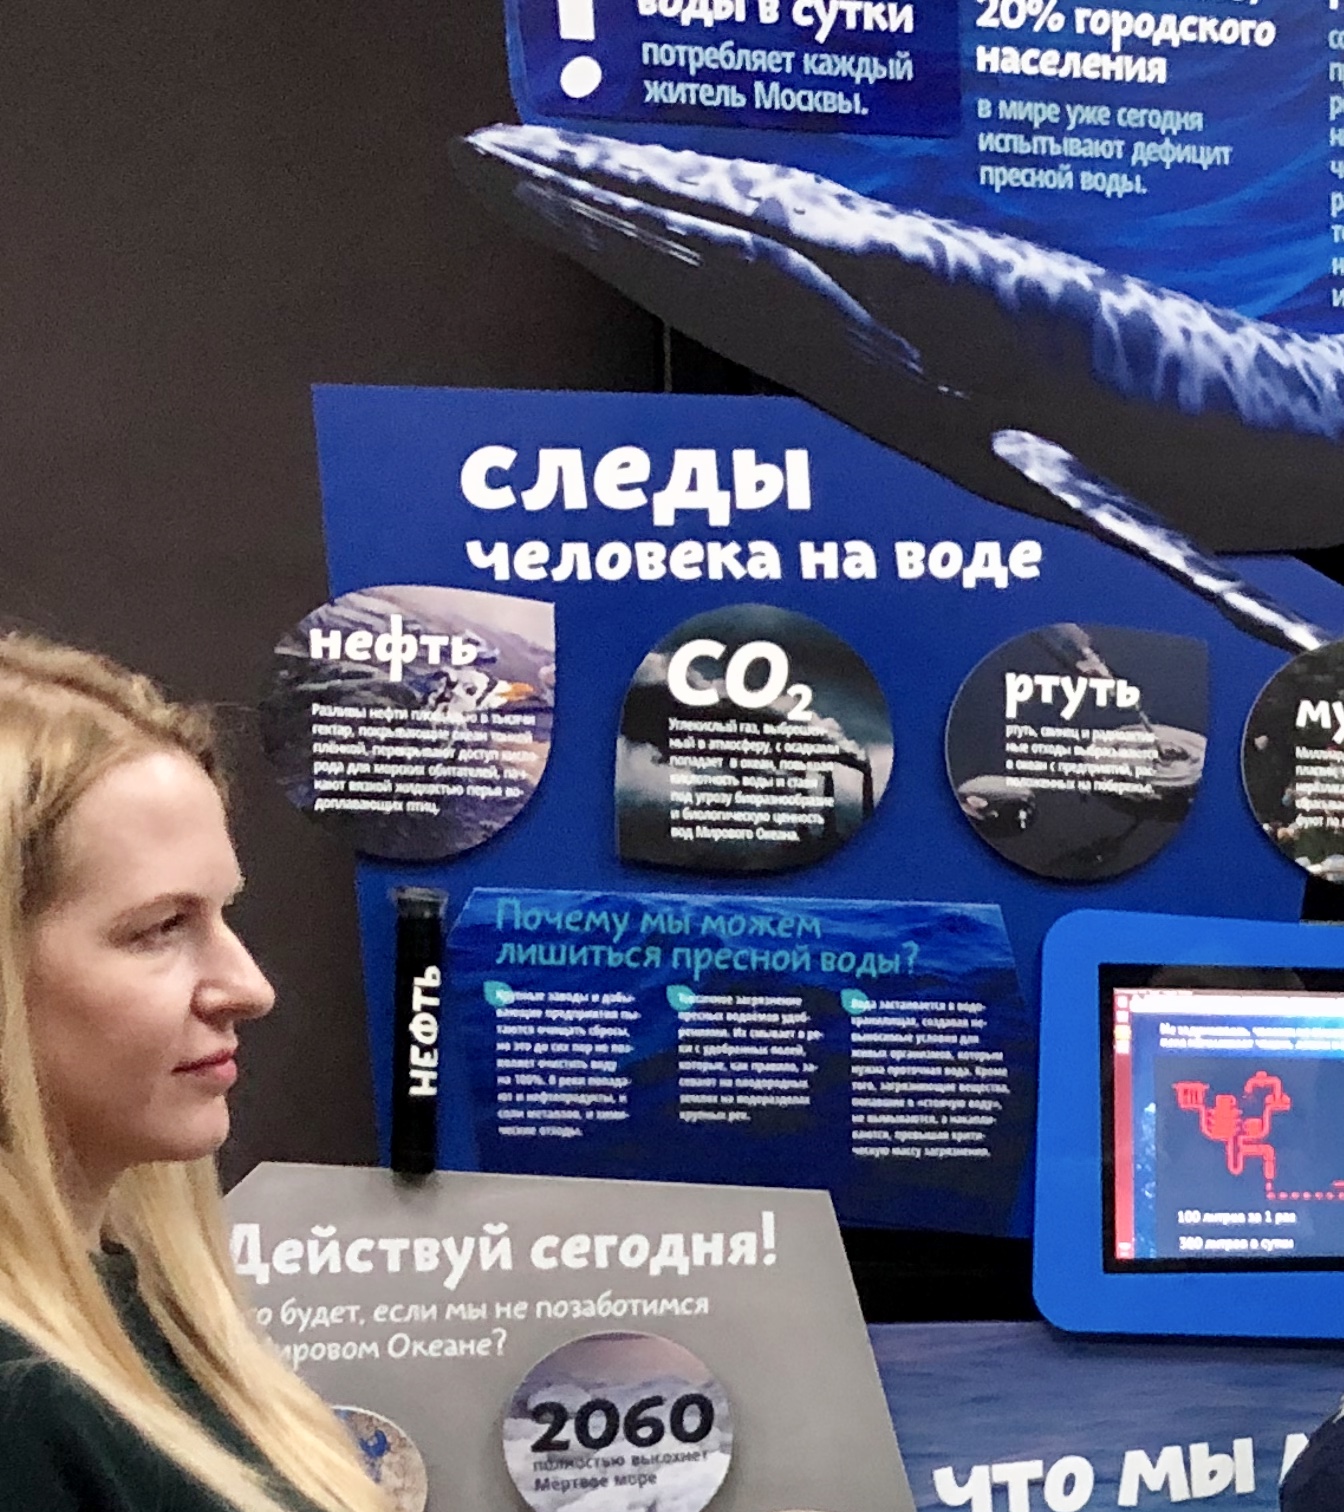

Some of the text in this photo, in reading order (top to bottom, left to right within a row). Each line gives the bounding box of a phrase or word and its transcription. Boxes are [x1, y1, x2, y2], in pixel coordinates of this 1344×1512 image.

[791, 0, 914, 44] сутки
[976, 0, 1276, 51] 20% городского
[642, 40, 914, 83] потребляет каждый
[976, 45, 1167, 84] населения
[644, 80, 870, 115] житель Москвы.
[977, 98, 1204, 135] в мире уже сегодня
[978, 131, 1234, 170] испытывают дефицит
[980, 163, 1148, 198] пресной воды.
[460, 444, 812, 528] следы
[465, 539, 1044, 589] человека на воде
[309, 613, 478, 683] нефть
[1005, 671, 1141, 721] ртуть
[496, 897, 823, 942] Почему мы можем
[496, 941, 920, 981] лишиться пресной воды?
[408, 965, 442, 1096] НЕФТЬ
[230, 1210, 777, 1289] Действуй сегодня!
[280, 1289, 710, 1333] будет, если мы не позаботимся
[386, 1327, 508, 1361] Океане?
[531, 1392, 715, 1454] 2060
[614, 1471, 657, 1491] море
[1117, 1436, 1255, 1509] мы
